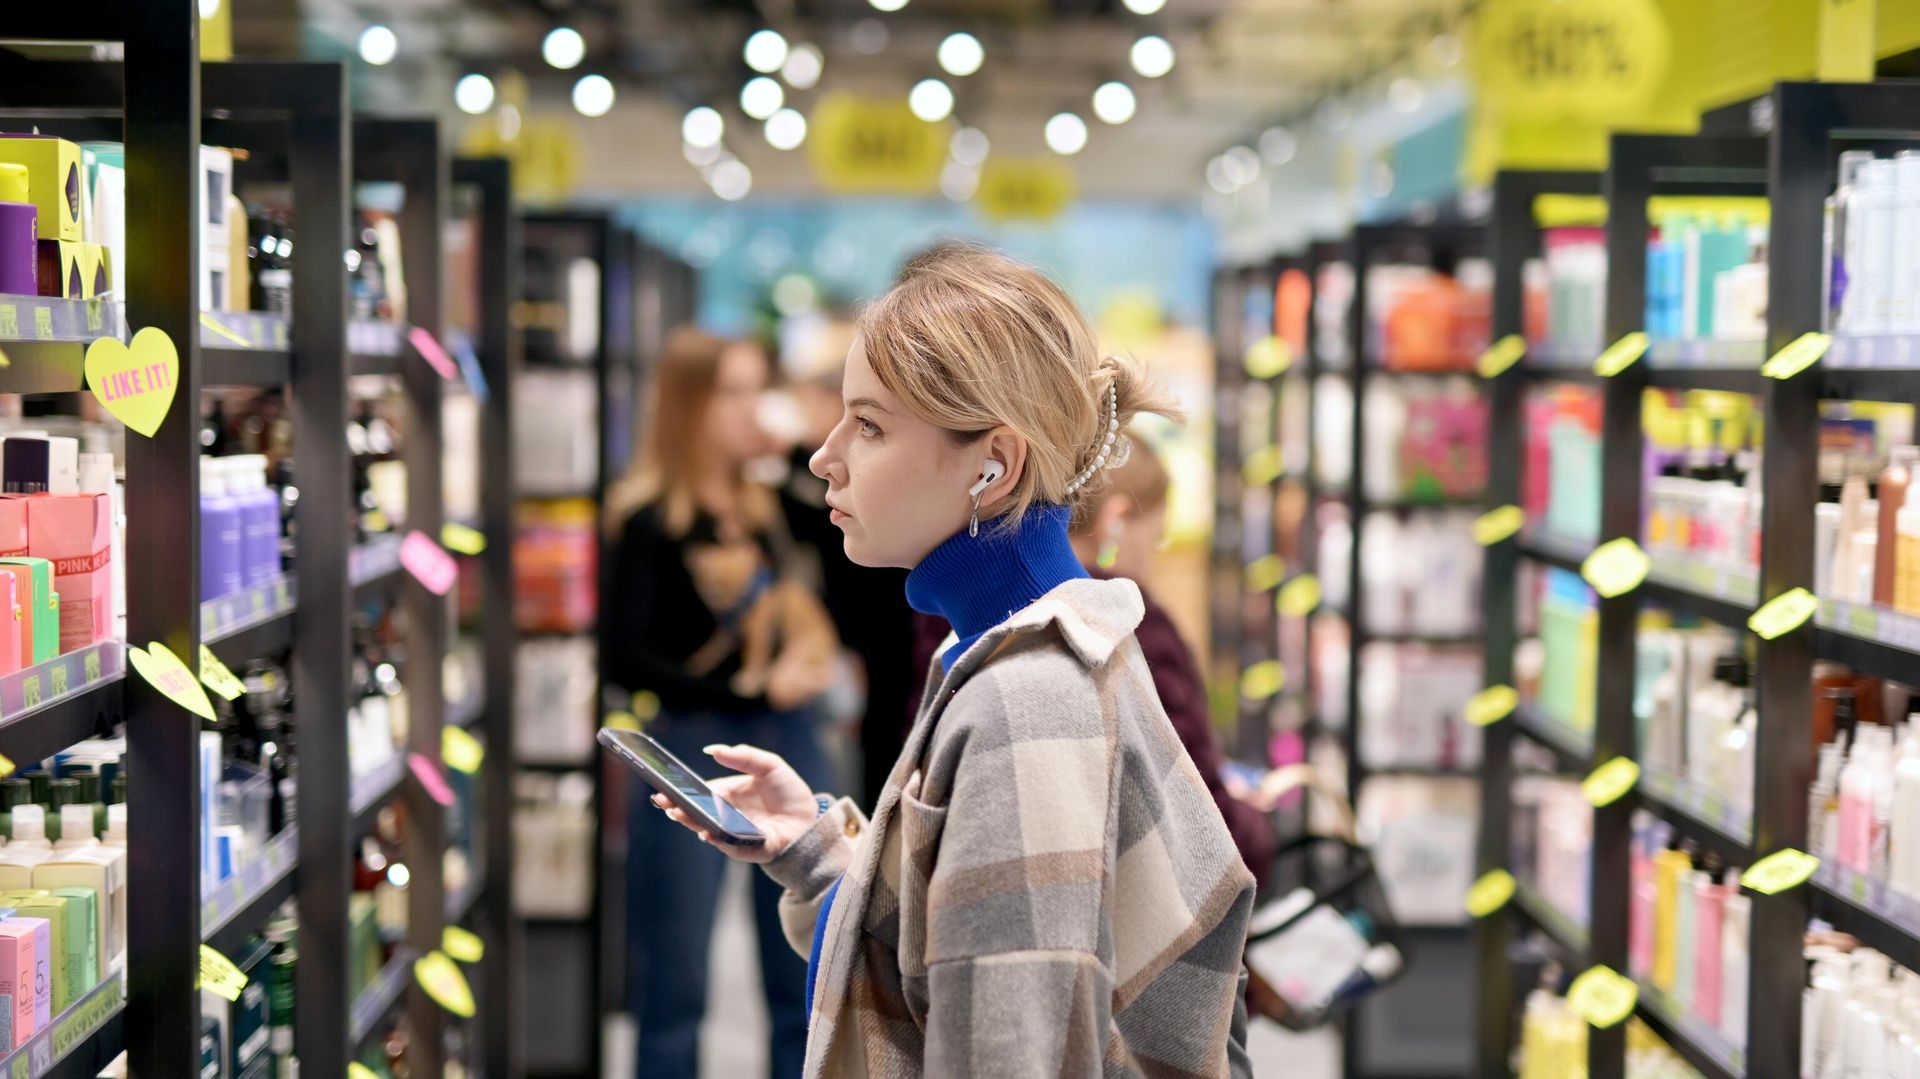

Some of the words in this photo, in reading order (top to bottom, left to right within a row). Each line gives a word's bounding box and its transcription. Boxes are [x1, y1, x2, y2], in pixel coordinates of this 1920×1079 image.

[101, 368, 144, 401] LIKE
[144, 362, 171, 391] IT!
[58, 558, 92, 575] PINK
[20, 969, 29, 1006] 5
[34, 959, 45, 995] 5
